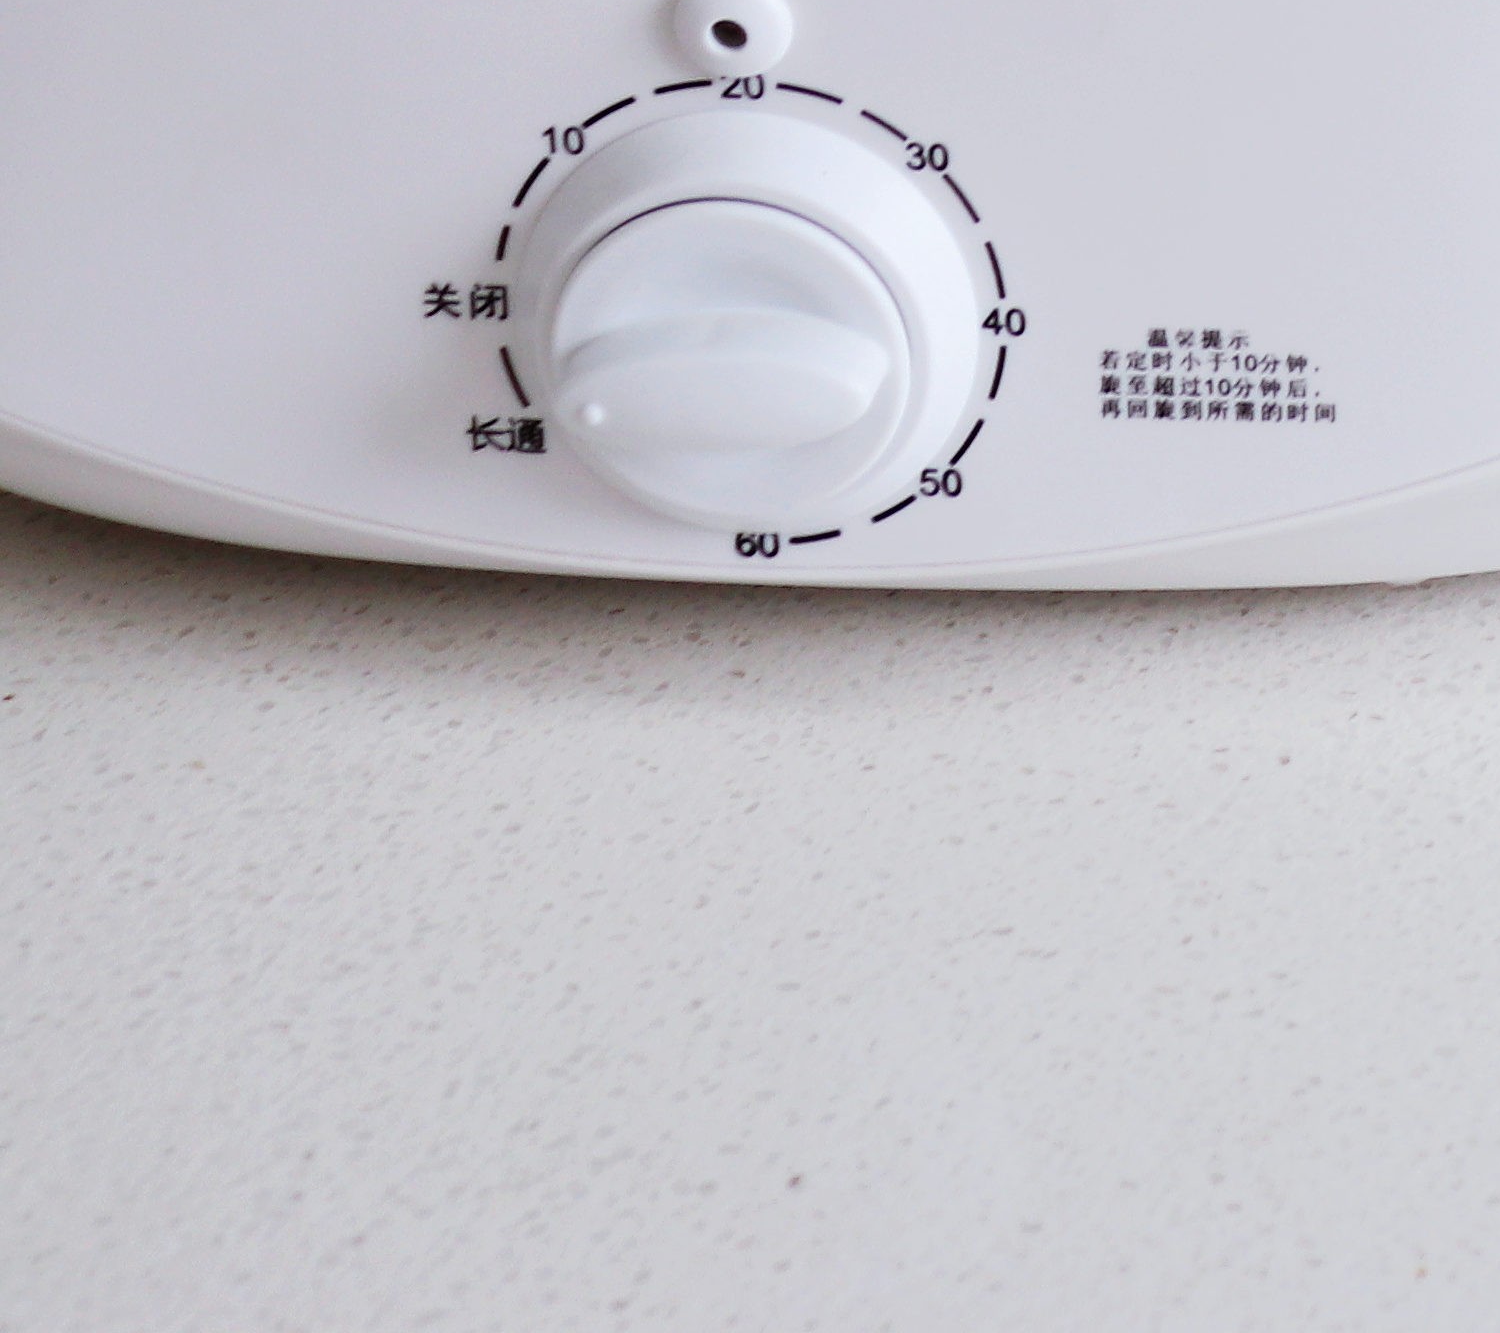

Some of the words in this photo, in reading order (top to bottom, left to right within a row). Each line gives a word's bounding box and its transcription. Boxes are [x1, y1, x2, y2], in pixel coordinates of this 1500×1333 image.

[721, 76, 765, 100] 20
[542, 124, 585, 157] 10
[905, 142, 949, 174] 30
[423, 282, 509, 321] 关闭
[982, 307, 1027, 338] 40
[1101, 399, 1337, 423] 再回旋到所需的时间
[466, 416, 547, 455] 长通
[919, 468, 963, 498] 50
[735, 532, 780, 559] 60
